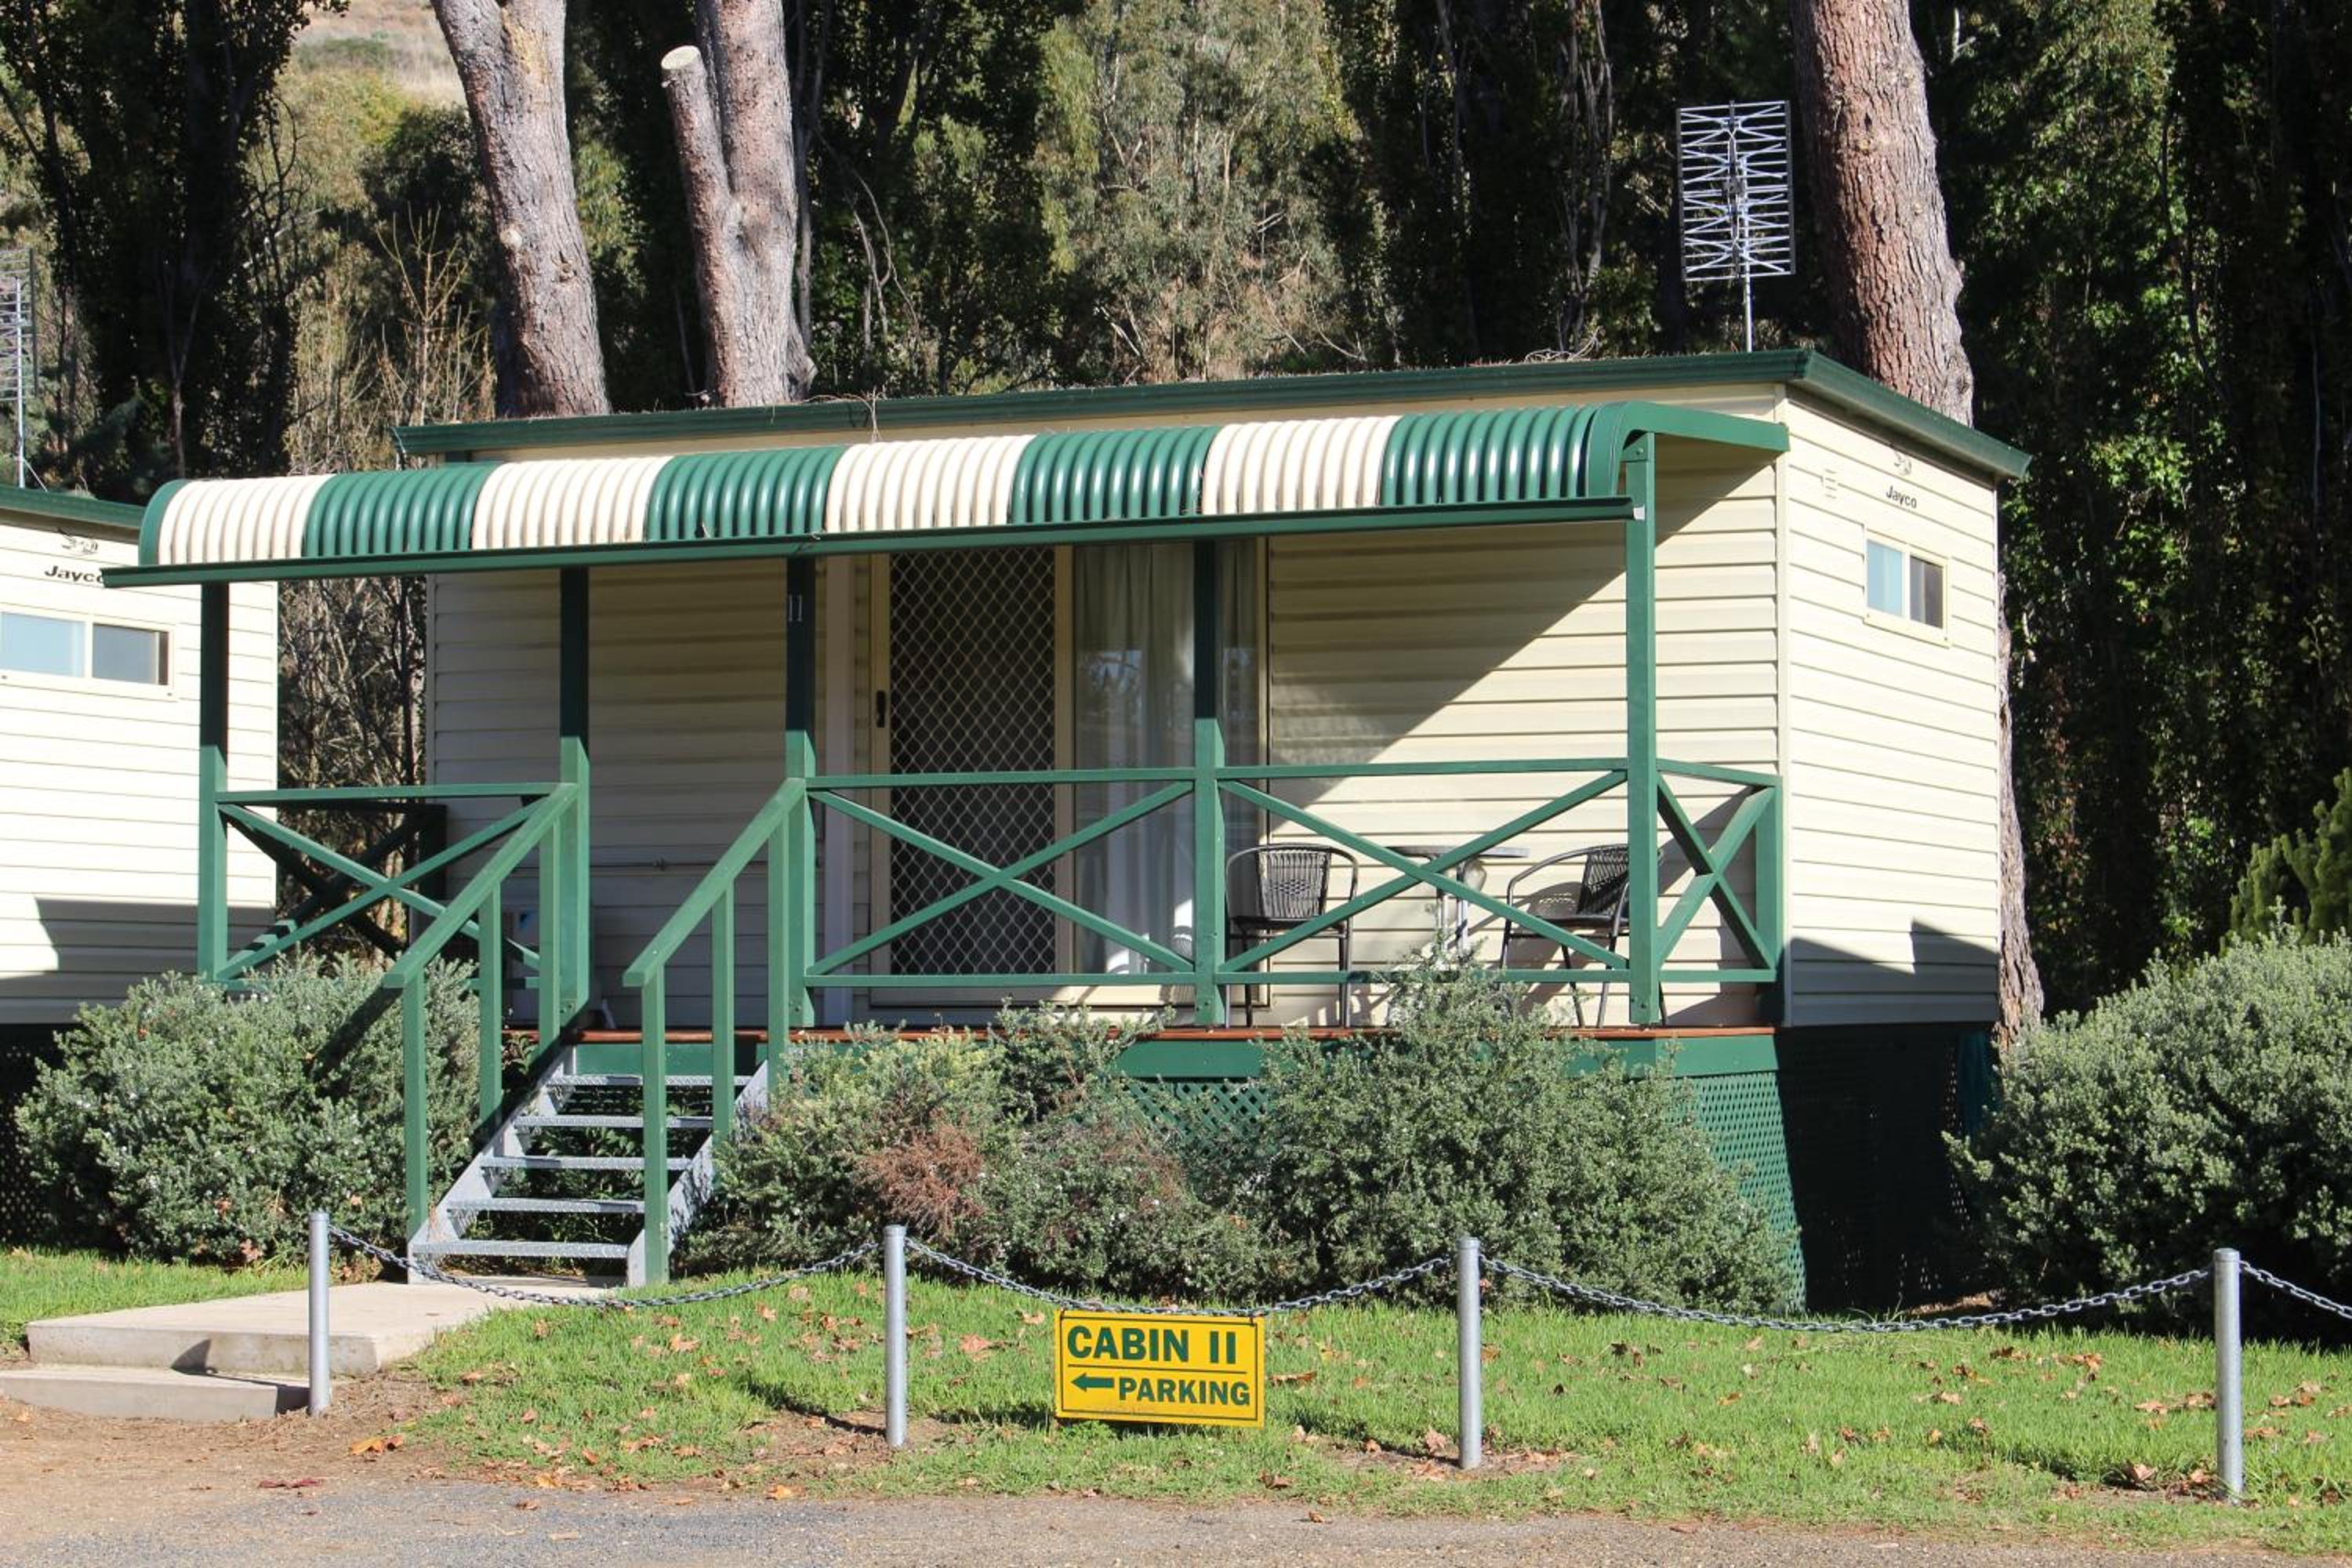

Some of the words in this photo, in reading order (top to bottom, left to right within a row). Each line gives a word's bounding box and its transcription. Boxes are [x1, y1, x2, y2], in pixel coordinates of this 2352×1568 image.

[1886, 485, 1918, 509] Jayco
[1067, 1325, 1189, 1363] CABIN
[1119, 1377, 1250, 1406] PARKING
